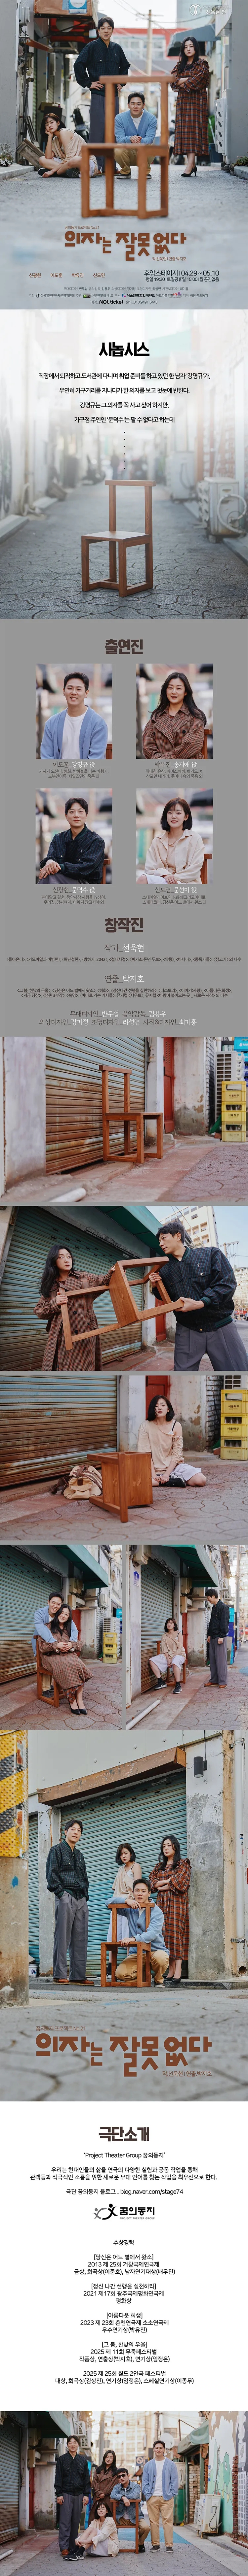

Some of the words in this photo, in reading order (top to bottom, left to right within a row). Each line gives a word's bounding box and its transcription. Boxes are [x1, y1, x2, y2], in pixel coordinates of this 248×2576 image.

[64, 231, 111, 253] 의자는
[116, 233, 150, 261] 잘못
[153, 233, 187, 254] 없다
[99, 342, 150, 357] 시놉시스
[105, 639, 143, 654] 출연진
[105, 918, 143, 933] 창작진
[104, 944, 144, 952] 작가_선욱현
[105, 975, 144, 983] 연출_박지호
[36, 2033, 103, 2066] 의자는
[109, 2036, 159, 2077] 잘못
[164, 2036, 212, 2066] 없다
[99, 2127, 149, 2141] 극단소개
[120, 2207, 154, 2216] 꿈의동지
